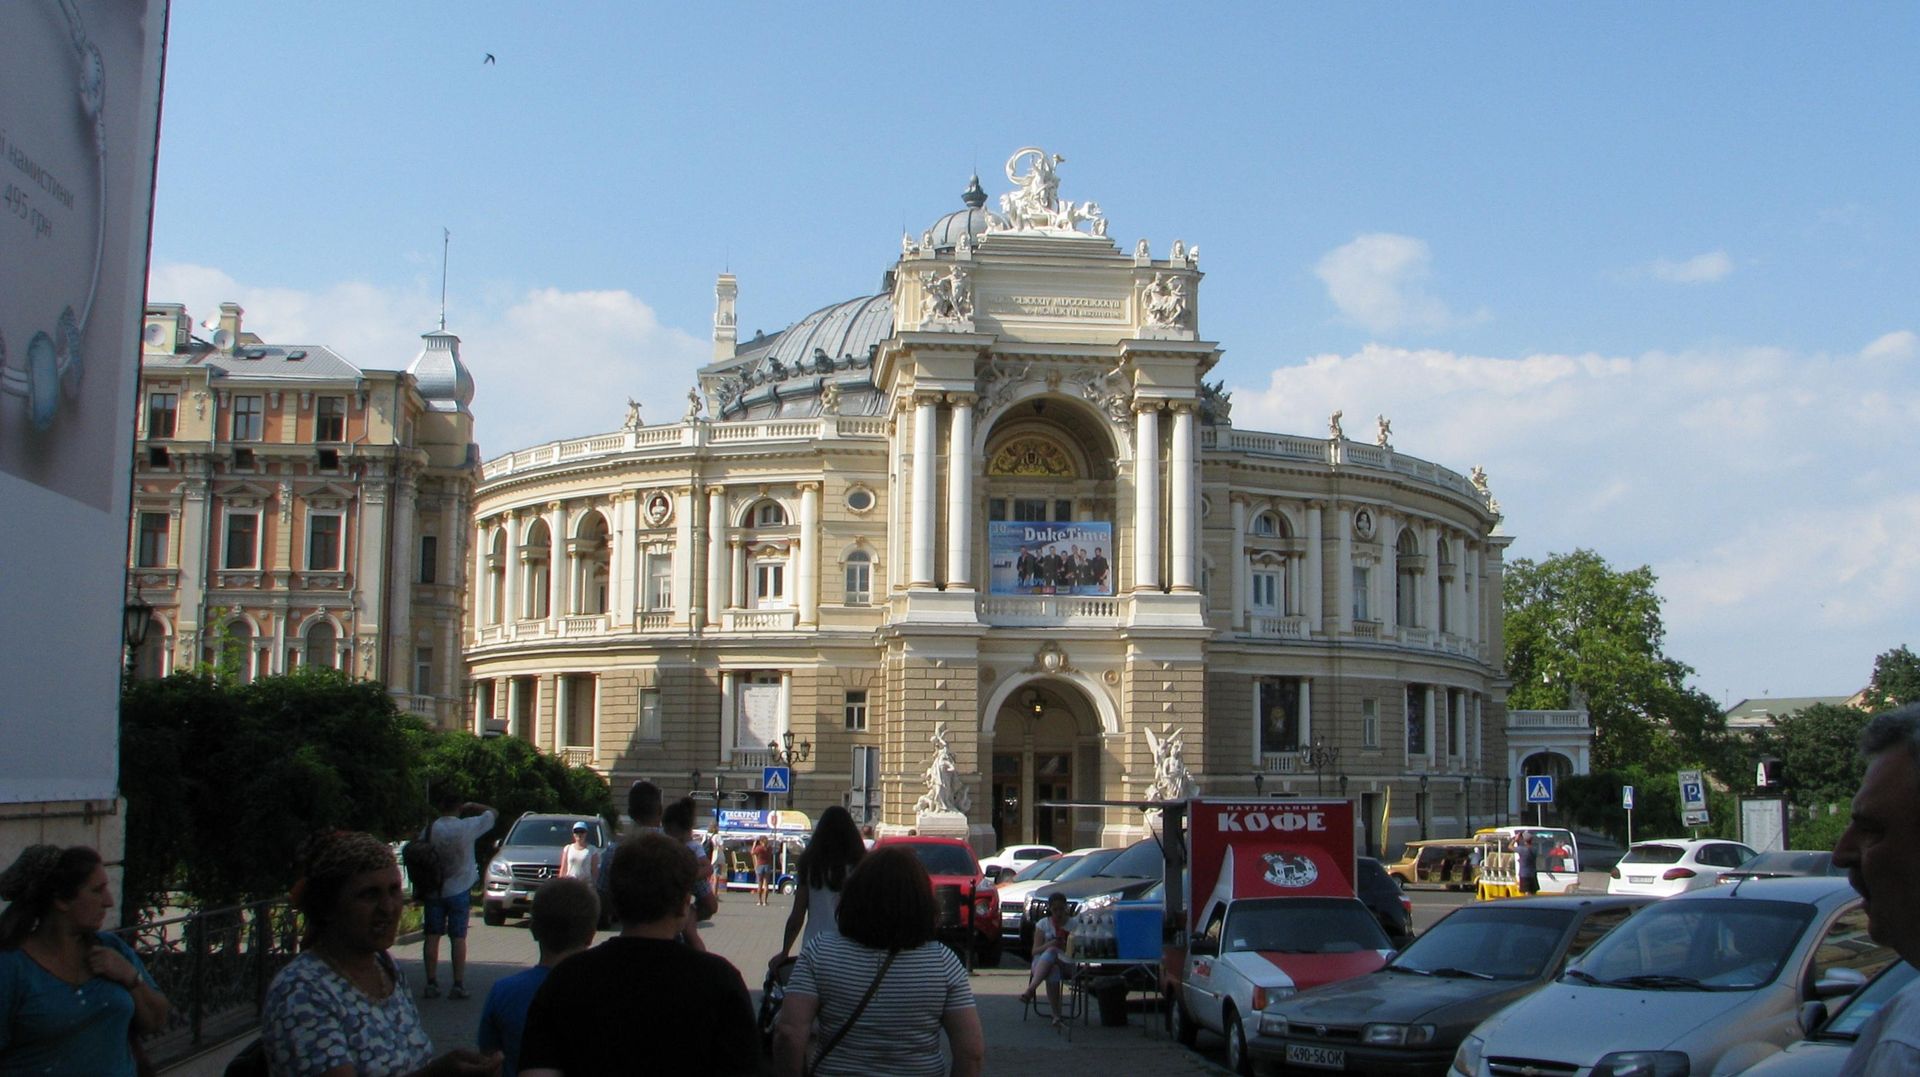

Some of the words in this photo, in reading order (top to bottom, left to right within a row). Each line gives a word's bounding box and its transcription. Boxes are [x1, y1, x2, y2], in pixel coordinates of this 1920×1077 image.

[4, 183, 28, 219] 495
[31, 208, 52, 239] грн
[1024, 527, 1108, 542] DukeTime
[1218, 812, 1327, 832] КОФЕ
[1293, 1046, 1326, 1063] 490-56
